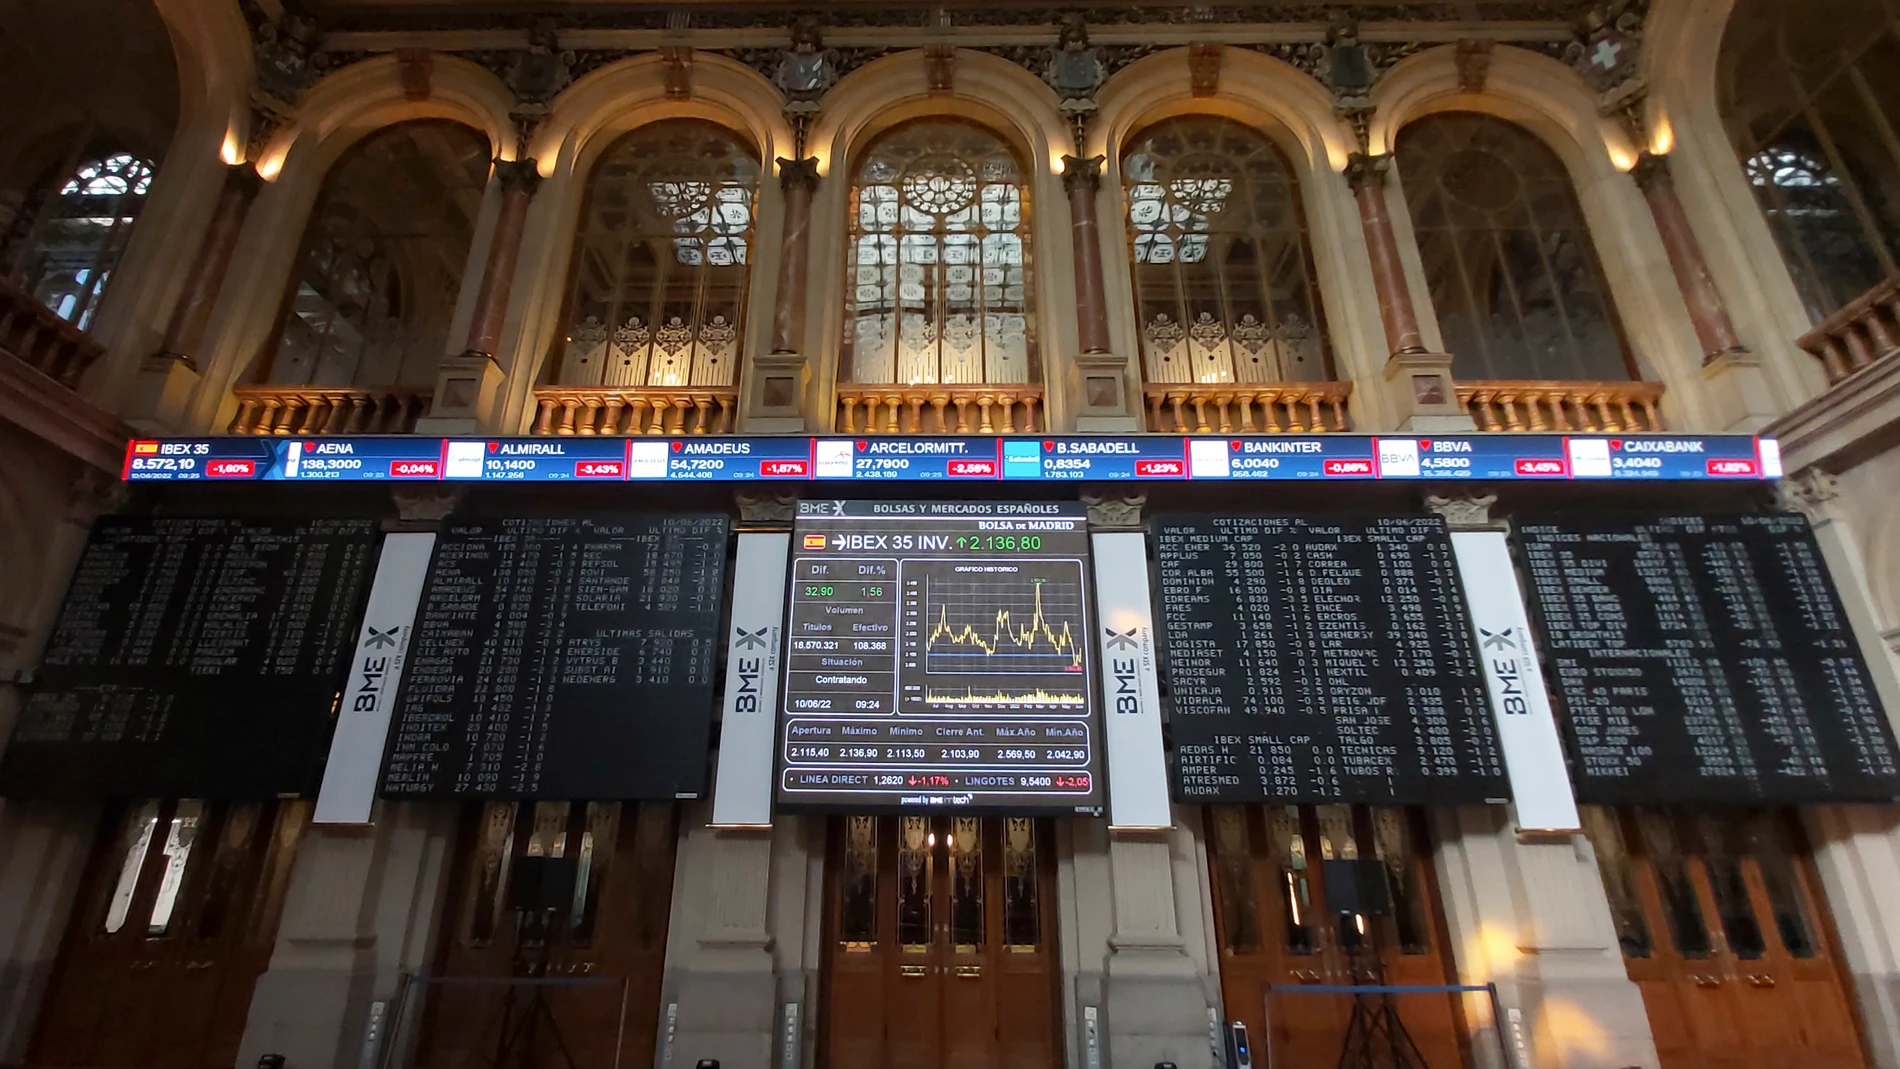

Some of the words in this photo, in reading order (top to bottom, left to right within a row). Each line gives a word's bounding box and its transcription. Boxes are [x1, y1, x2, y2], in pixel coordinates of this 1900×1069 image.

[161, 444, 191, 454] IBEX
[193, 444, 209, 454] 35
[316, 443, 354, 454] AENA
[500, 444, 565, 454] ALMIRALL
[684, 444, 750, 454] AMADEUS
[869, 442, 968, 453] ARCELORMITT.
[1057, 443, 1140, 454] B.SABADELL
[1244, 442, 1322, 453] BANKINTER
[1433, 441, 1472, 452] BBVA
[1624, 441, 1704, 452] CAIXABANK
[132, 458, 195, 470] 8.572,10
[1232, 458, 1279, 469] 6,0040
[1382, 454, 1415, 463] BBVA
[1421, 457, 1470, 468] 4,5800
[1613, 457, 1661, 468] 3,4040
[213, 464, 249, 473] -1,60%
[301, 459, 361, 470] 138,3000
[395, 464, 434, 474] -0,04%
[486, 460, 536, 470] 10,1400
[580, 465, 618, 474] -3,43%
[671, 459, 724, 470] 54,7200
[1043, 459, 1090, 470] 0,8354
[800, 503, 829, 514] BME
[873, 504, 915, 513] BOLSAS
[920, 504, 926, 513] Y
[931, 504, 992, 514] MERCADOS
[997, 502, 1059, 514] ESPAÑOLES
[978, 521, 1013, 530] BOLSA
[1028, 521, 1074, 530] MADRID
[847, 535, 888, 549] IBEX
[892, 535, 912, 549] 35
[918, 536, 952, 550] INV.
[970, 536, 1040, 552] 2.136,80
[812, 566, 829, 574] Dif.
[858, 566, 886, 575] Dif.%
[805, 587, 833, 596] 32,90
[861, 588, 883, 597] 1,56
[1141, 627, 1149, 654] company
[354, 657, 386, 712] BME
[735, 658, 759, 712] BME
[816, 676, 867, 684] Contratando
[1113, 658, 1138, 714] BME
[1494, 658, 1526, 715] BME
[795, 700, 831, 708] 10/06/22
[856, 700, 880, 708] 09:24
[792, 726, 831, 735] Apertura
[842, 726, 877, 735] Máximo
[936, 727, 963, 736] Cierre
[996, 727, 1036, 736] Máx.Año
[791, 748, 829, 758] 2.115,40
[840, 748, 878, 758] 2.136,90
[887, 749, 925, 758] 2.113,50
[941, 749, 980, 759] 2.103,90
[997, 750, 1036, 759] 2.569,50
[1046, 750, 1085, 759] 2.042,90
[1181, 756, 1236, 764] AIRTIFIC
[1258, 756, 1292, 764] 0.084
[1259, 766, 1294, 774] 0.245
[800, 775, 829, 784] LINEA
[832, 775, 868, 784] DIRECT
[874, 776, 903, 785] 1,2620
[918, 776, 949, 786] -1,17%
[965, 777, 1015, 786] LINGOTES
[1020, 777, 1051, 787] 9,5400
[1183, 776, 1239, 784] ATRESMED
[1184, 786, 1220, 795] AUDAX
[1263, 787, 1297, 795] 1.270
[901, 796, 921, 804] powered
[922, 796, 929, 805] by
